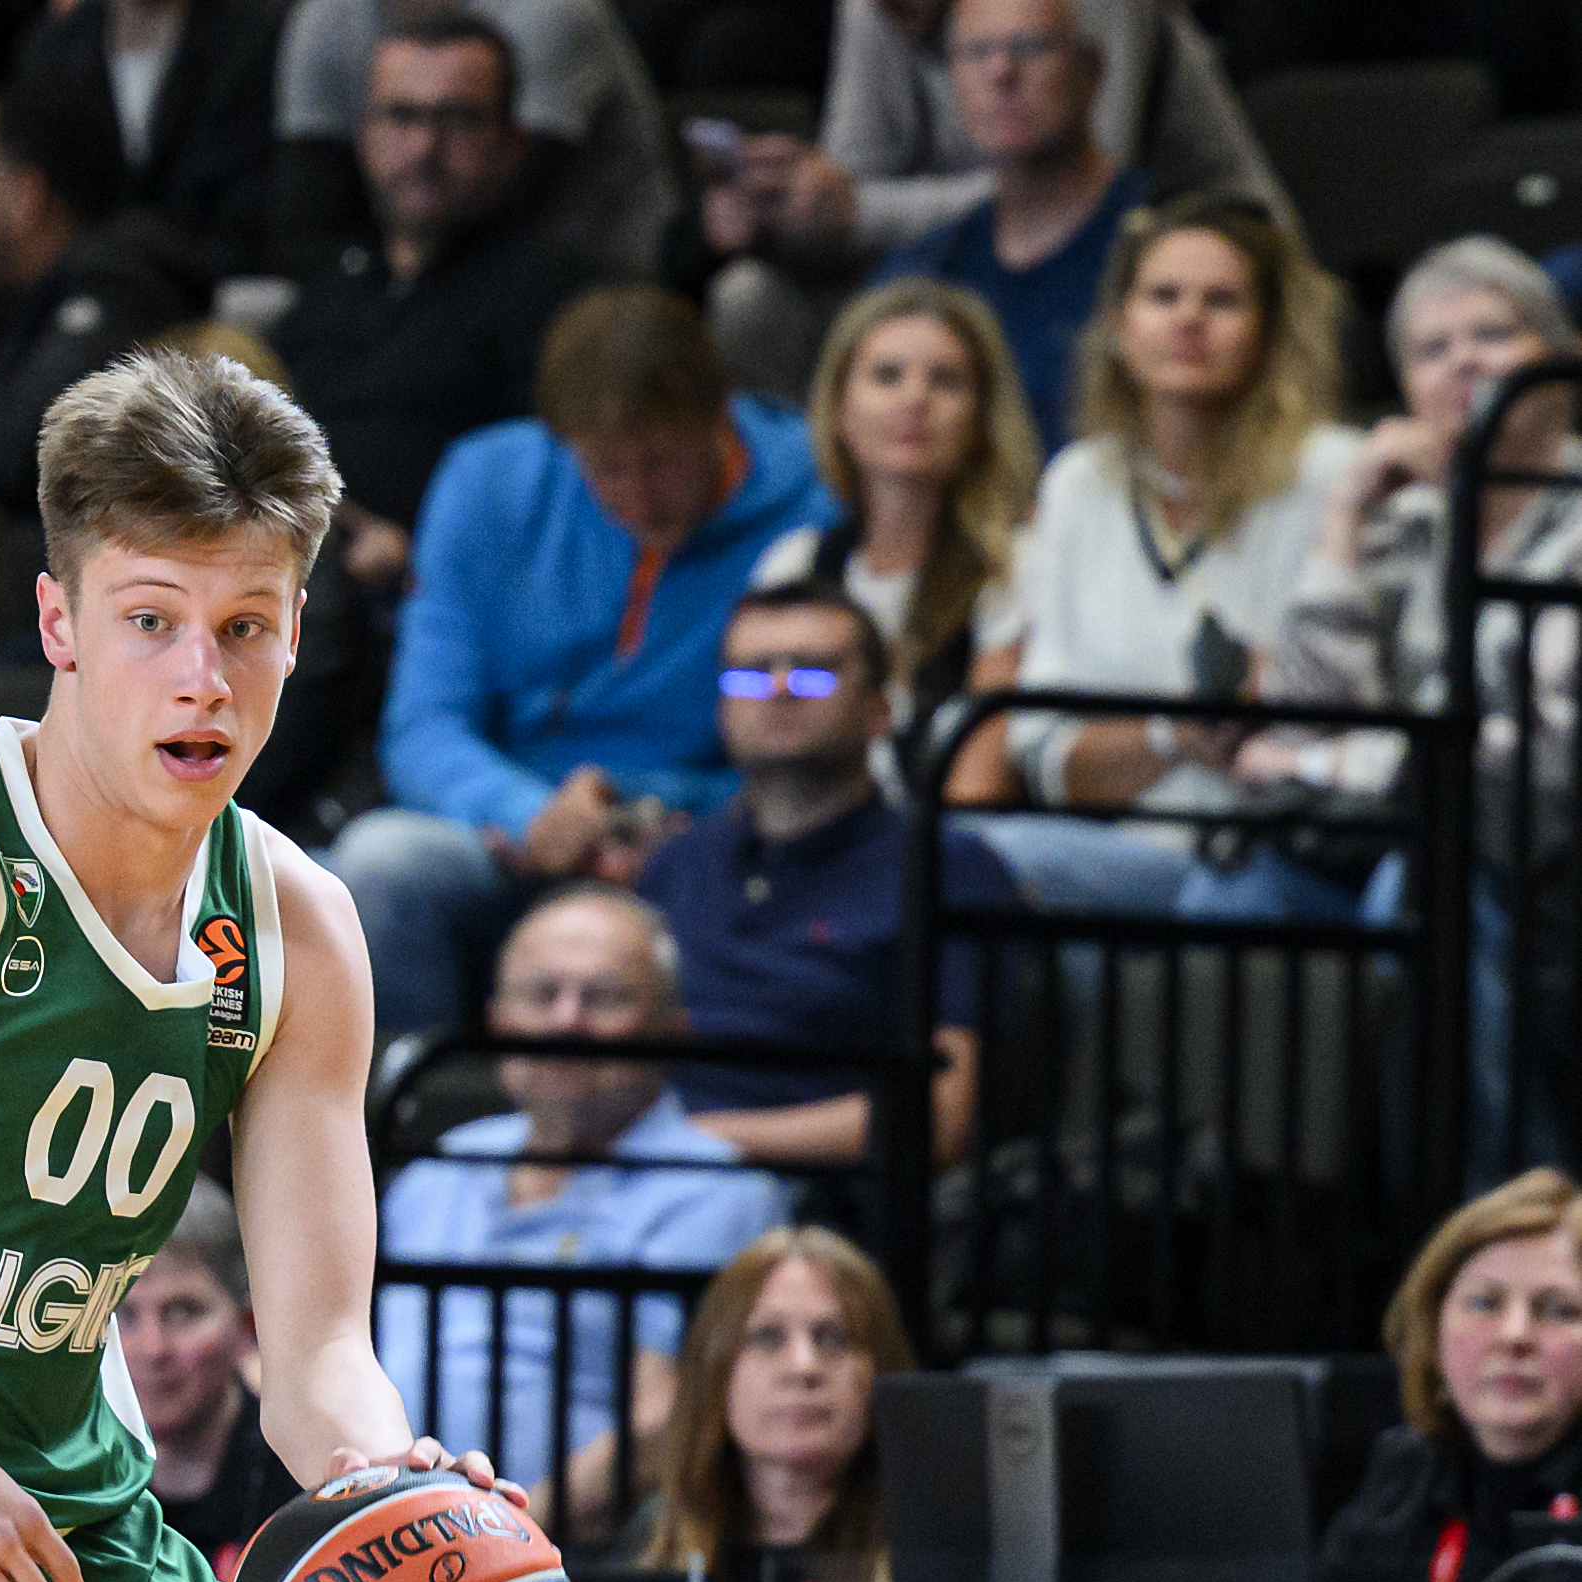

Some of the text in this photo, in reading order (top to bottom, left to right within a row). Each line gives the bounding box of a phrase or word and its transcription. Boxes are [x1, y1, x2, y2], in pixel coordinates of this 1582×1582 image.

[8, 959, 40, 972] GSA
[209, 1007, 242, 1021] League
[25, 1058, 196, 1218] 00
